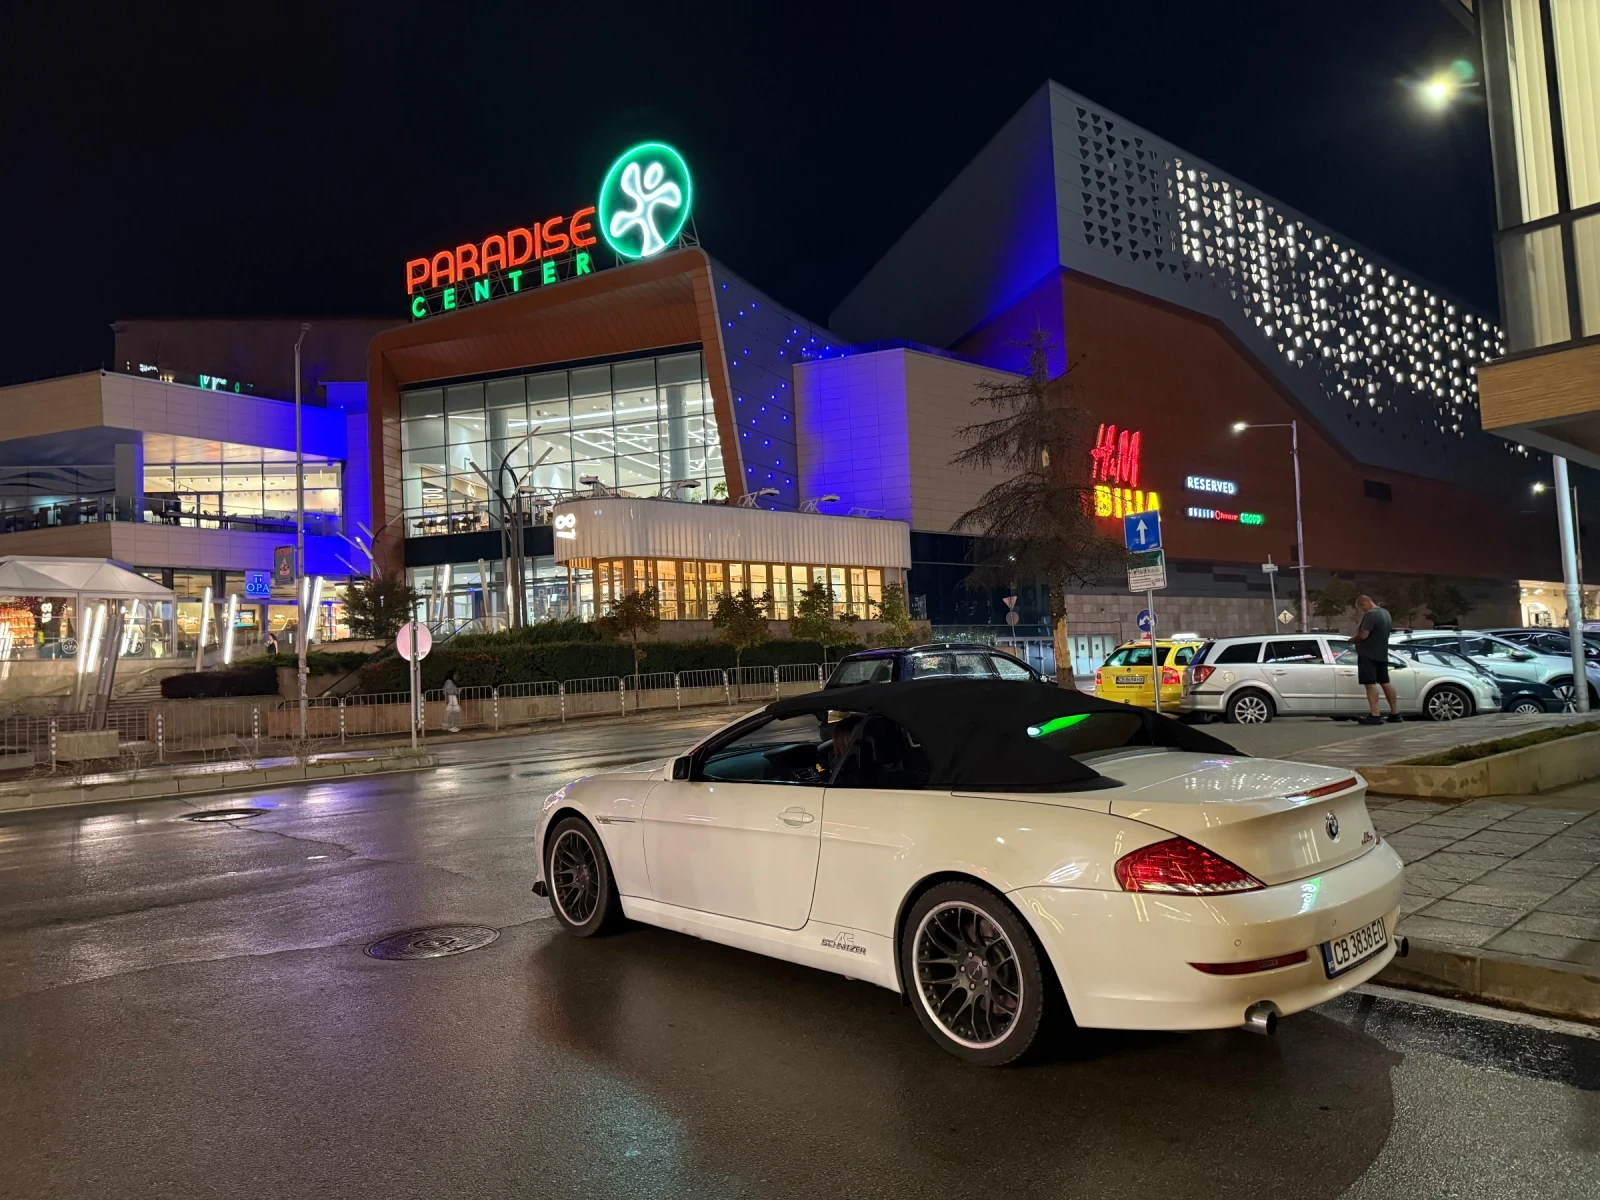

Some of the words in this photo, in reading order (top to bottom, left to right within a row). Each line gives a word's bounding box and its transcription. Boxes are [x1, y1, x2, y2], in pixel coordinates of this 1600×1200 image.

[405, 206, 597, 295] PARADISE
[411, 252, 592, 318] CENTER
[1187, 476, 1235, 495] RESERVED
[246, 583, 270, 592] OPA
[820, 938, 867, 956] SCHNITZER
[1333, 938, 1350, 965] CB
[1349, 926, 1373, 958] 3838
